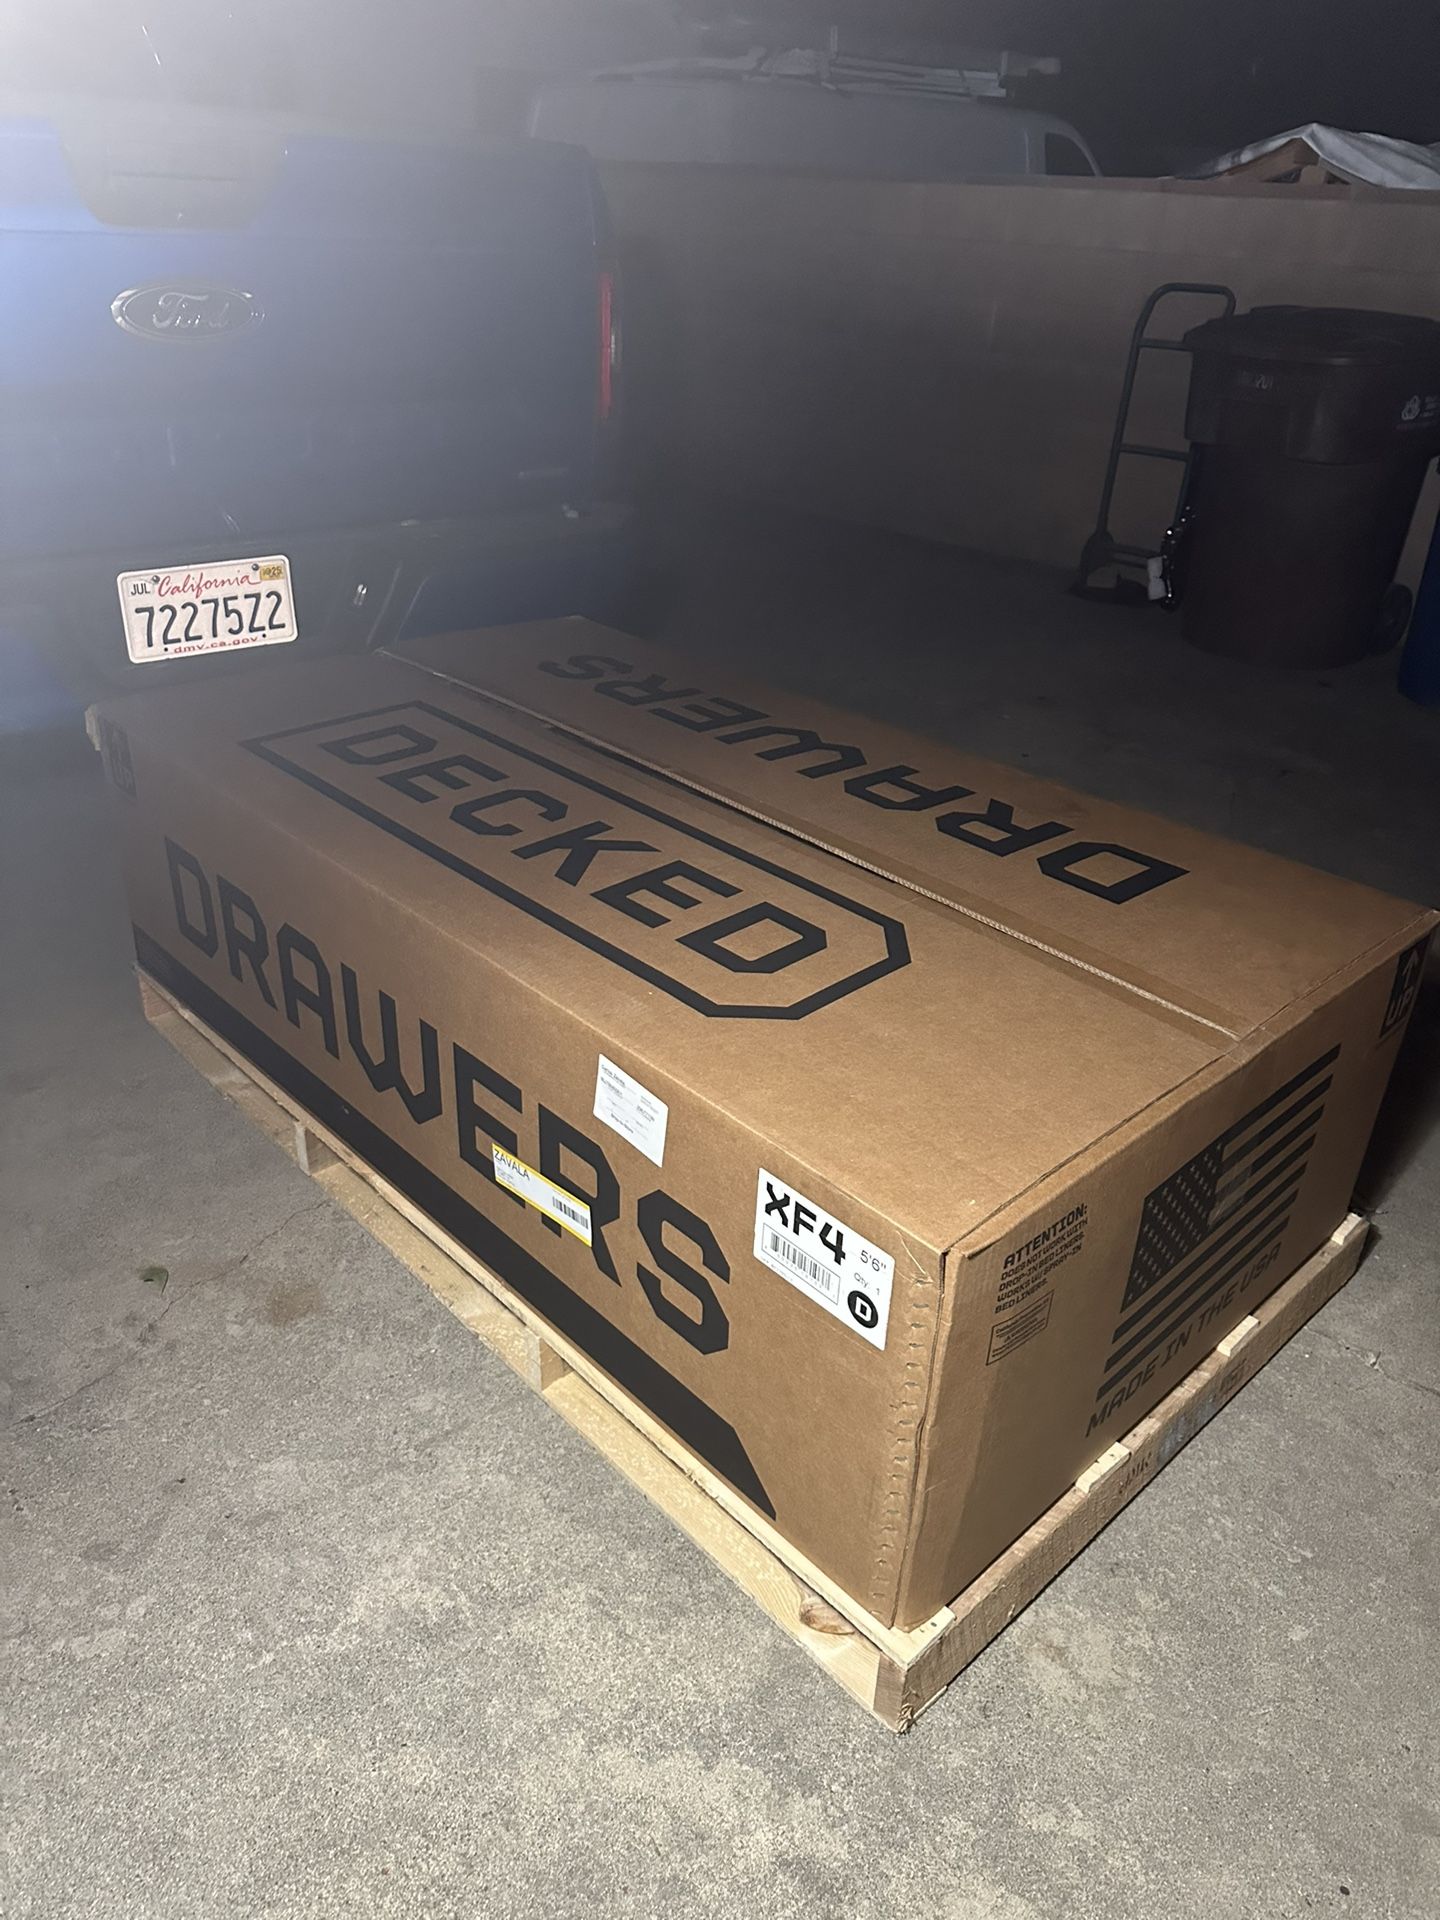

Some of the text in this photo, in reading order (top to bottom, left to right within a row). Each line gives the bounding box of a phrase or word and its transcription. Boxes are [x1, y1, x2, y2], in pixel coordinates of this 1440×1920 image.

[153, 291, 230, 330] Ford
[130, 582, 151, 597] JUL
[157, 570, 262, 599] California
[134, 590, 287, 649] 72275Z2
[174, 636, 259, 654] dmv.ca.gov
[538, 654, 1190, 905] DRAWERS
[320, 723, 827, 974] DECKED
[164, 836, 731, 1355] DRAWERS
[494, 1149, 530, 1181] ZAVALA
[764, 1181, 846, 1266] XF4
[1003, 1203, 1088, 1270] ATTENTION:
[999, 1263, 1039, 1291] DROP-IN
[1039, 1251, 1056, 1270] BED
[1000, 1261, 1026, 1281] DOES
[1026, 1249, 1043, 1268] NOT
[1066, 1217, 1088, 1239] WITH
[994, 1299, 1016, 1314] BED
[997, 1278, 1031, 1302] WORKS
[1085, 1354, 1159, 1438] MADE
[1161, 1323, 1193, 1368] IN
[1198, 1281, 1239, 1333] THE
[1239, 1242, 1282, 1294] USA
